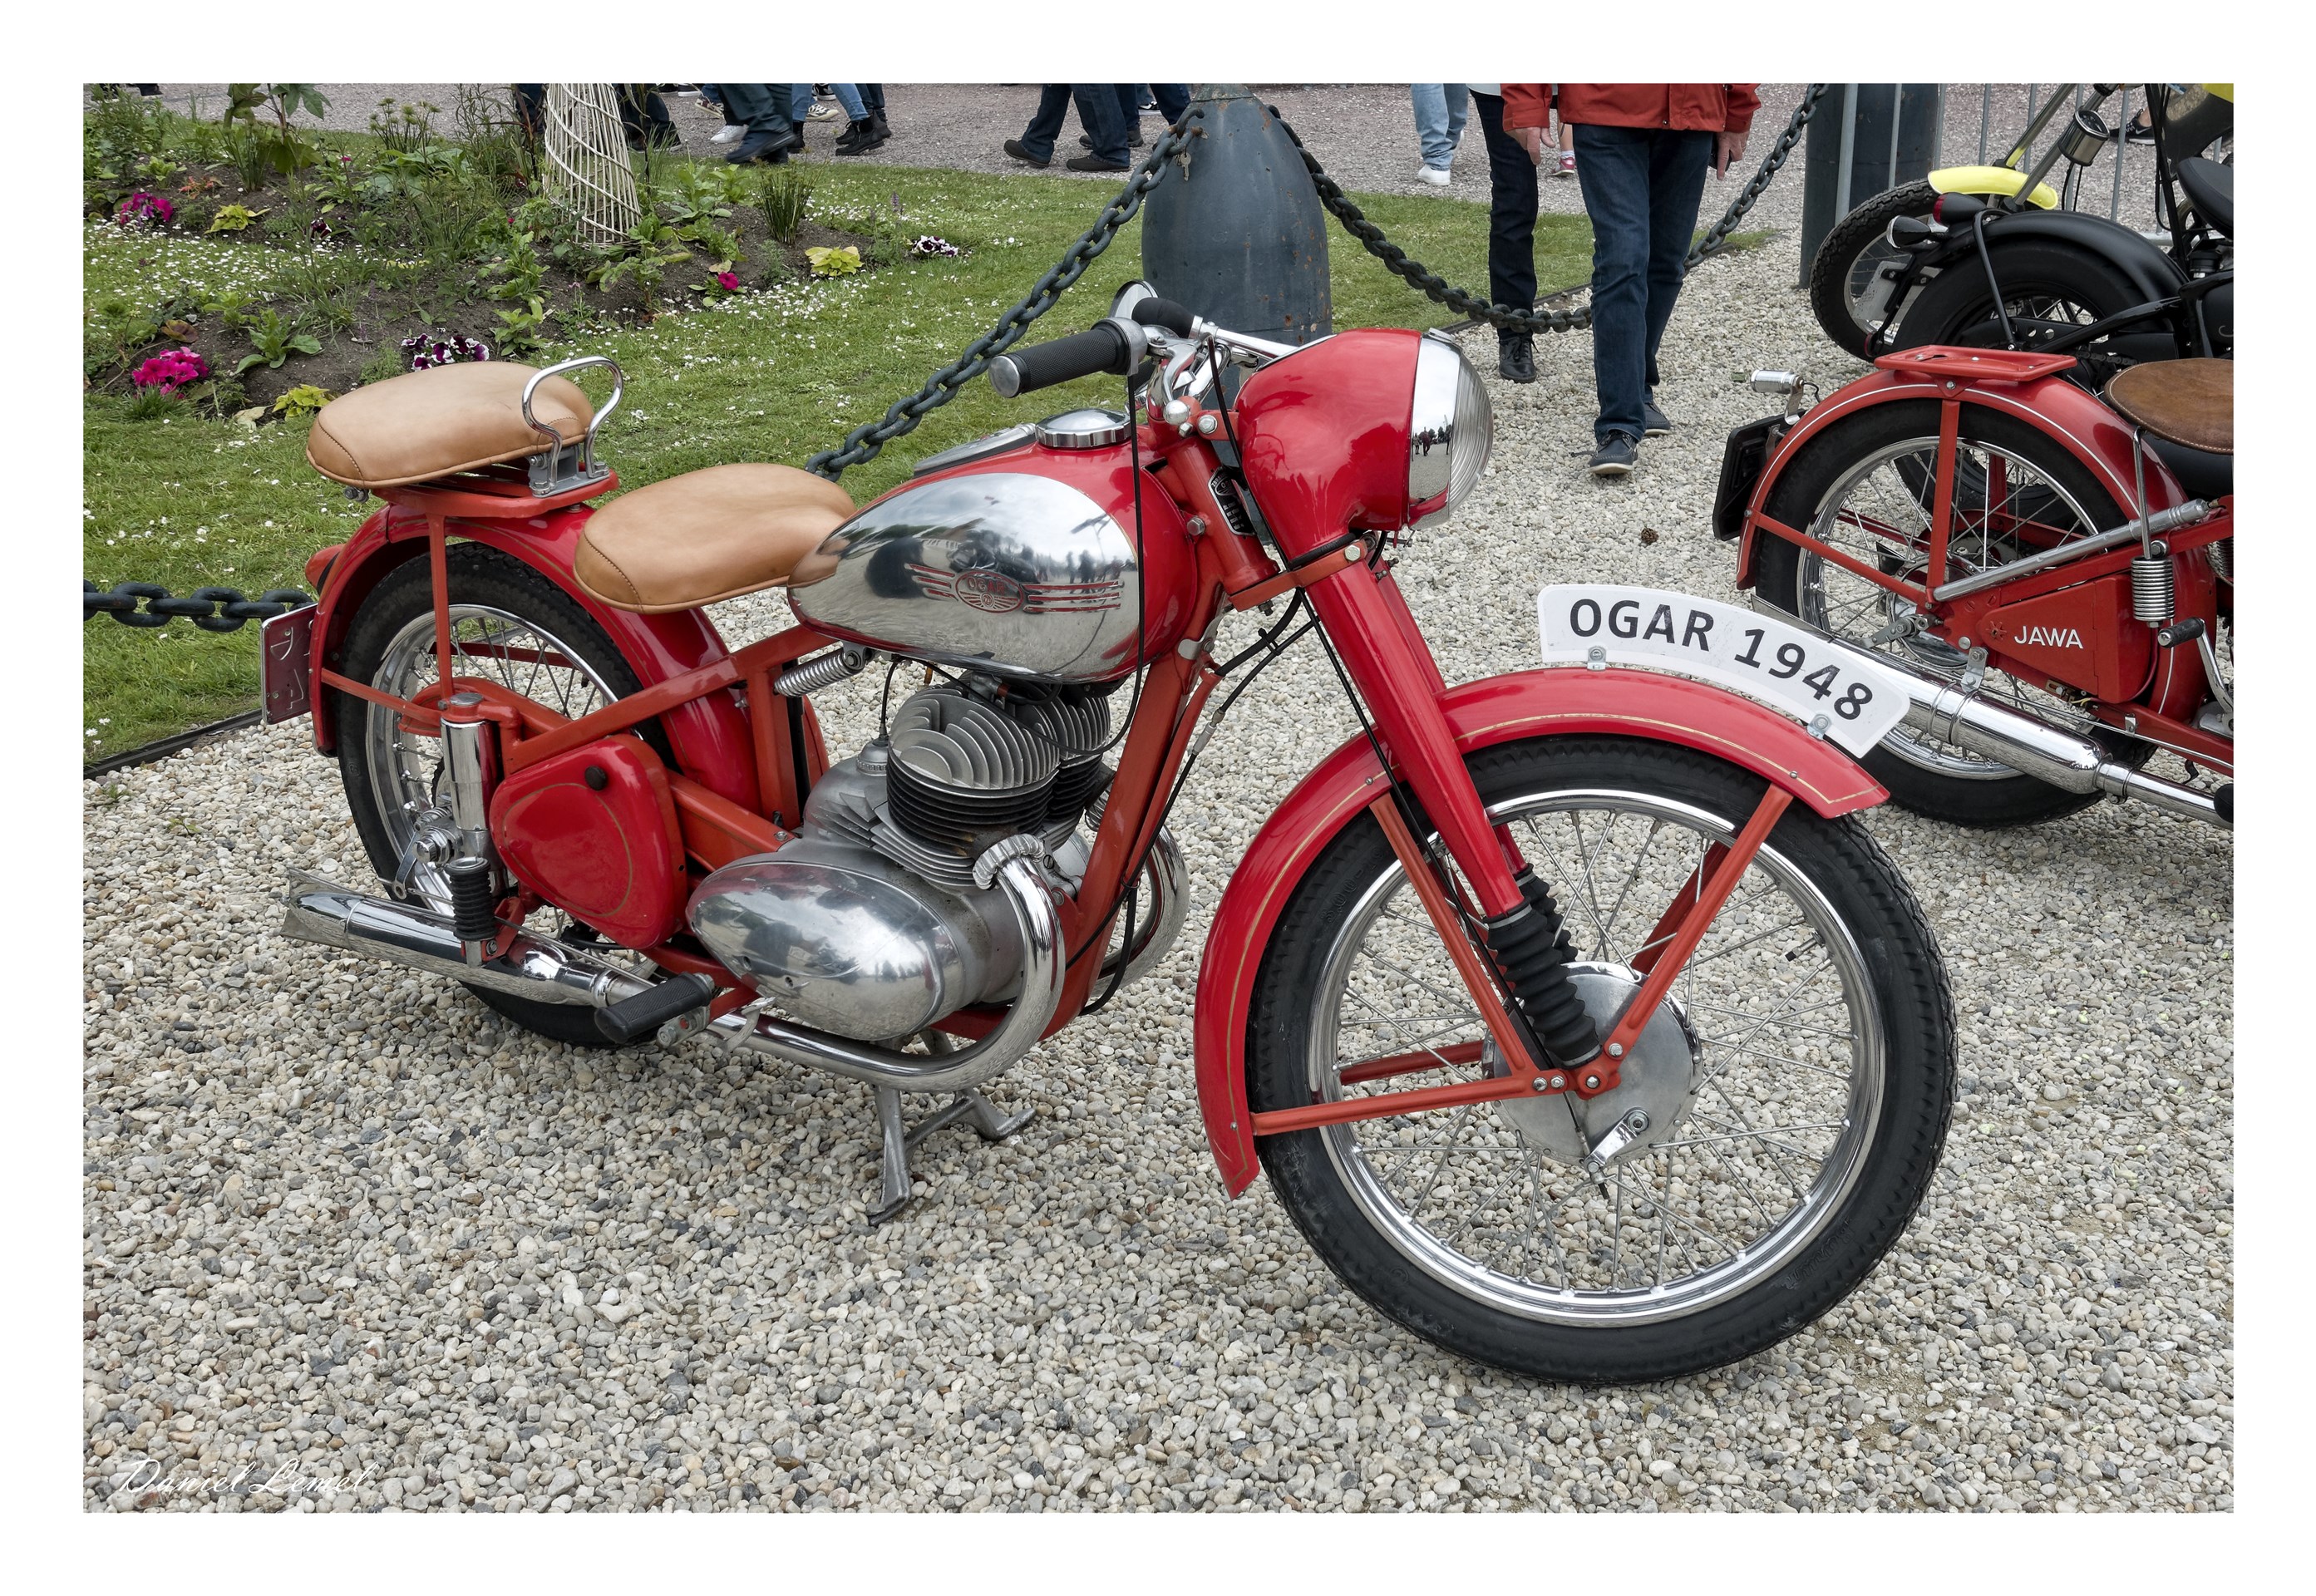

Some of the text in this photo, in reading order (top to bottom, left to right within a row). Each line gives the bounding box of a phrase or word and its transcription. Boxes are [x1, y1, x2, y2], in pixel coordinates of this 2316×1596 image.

[1569, 598, 1874, 721] OGAR 1948
[2013, 625, 2084, 649] JAWA
